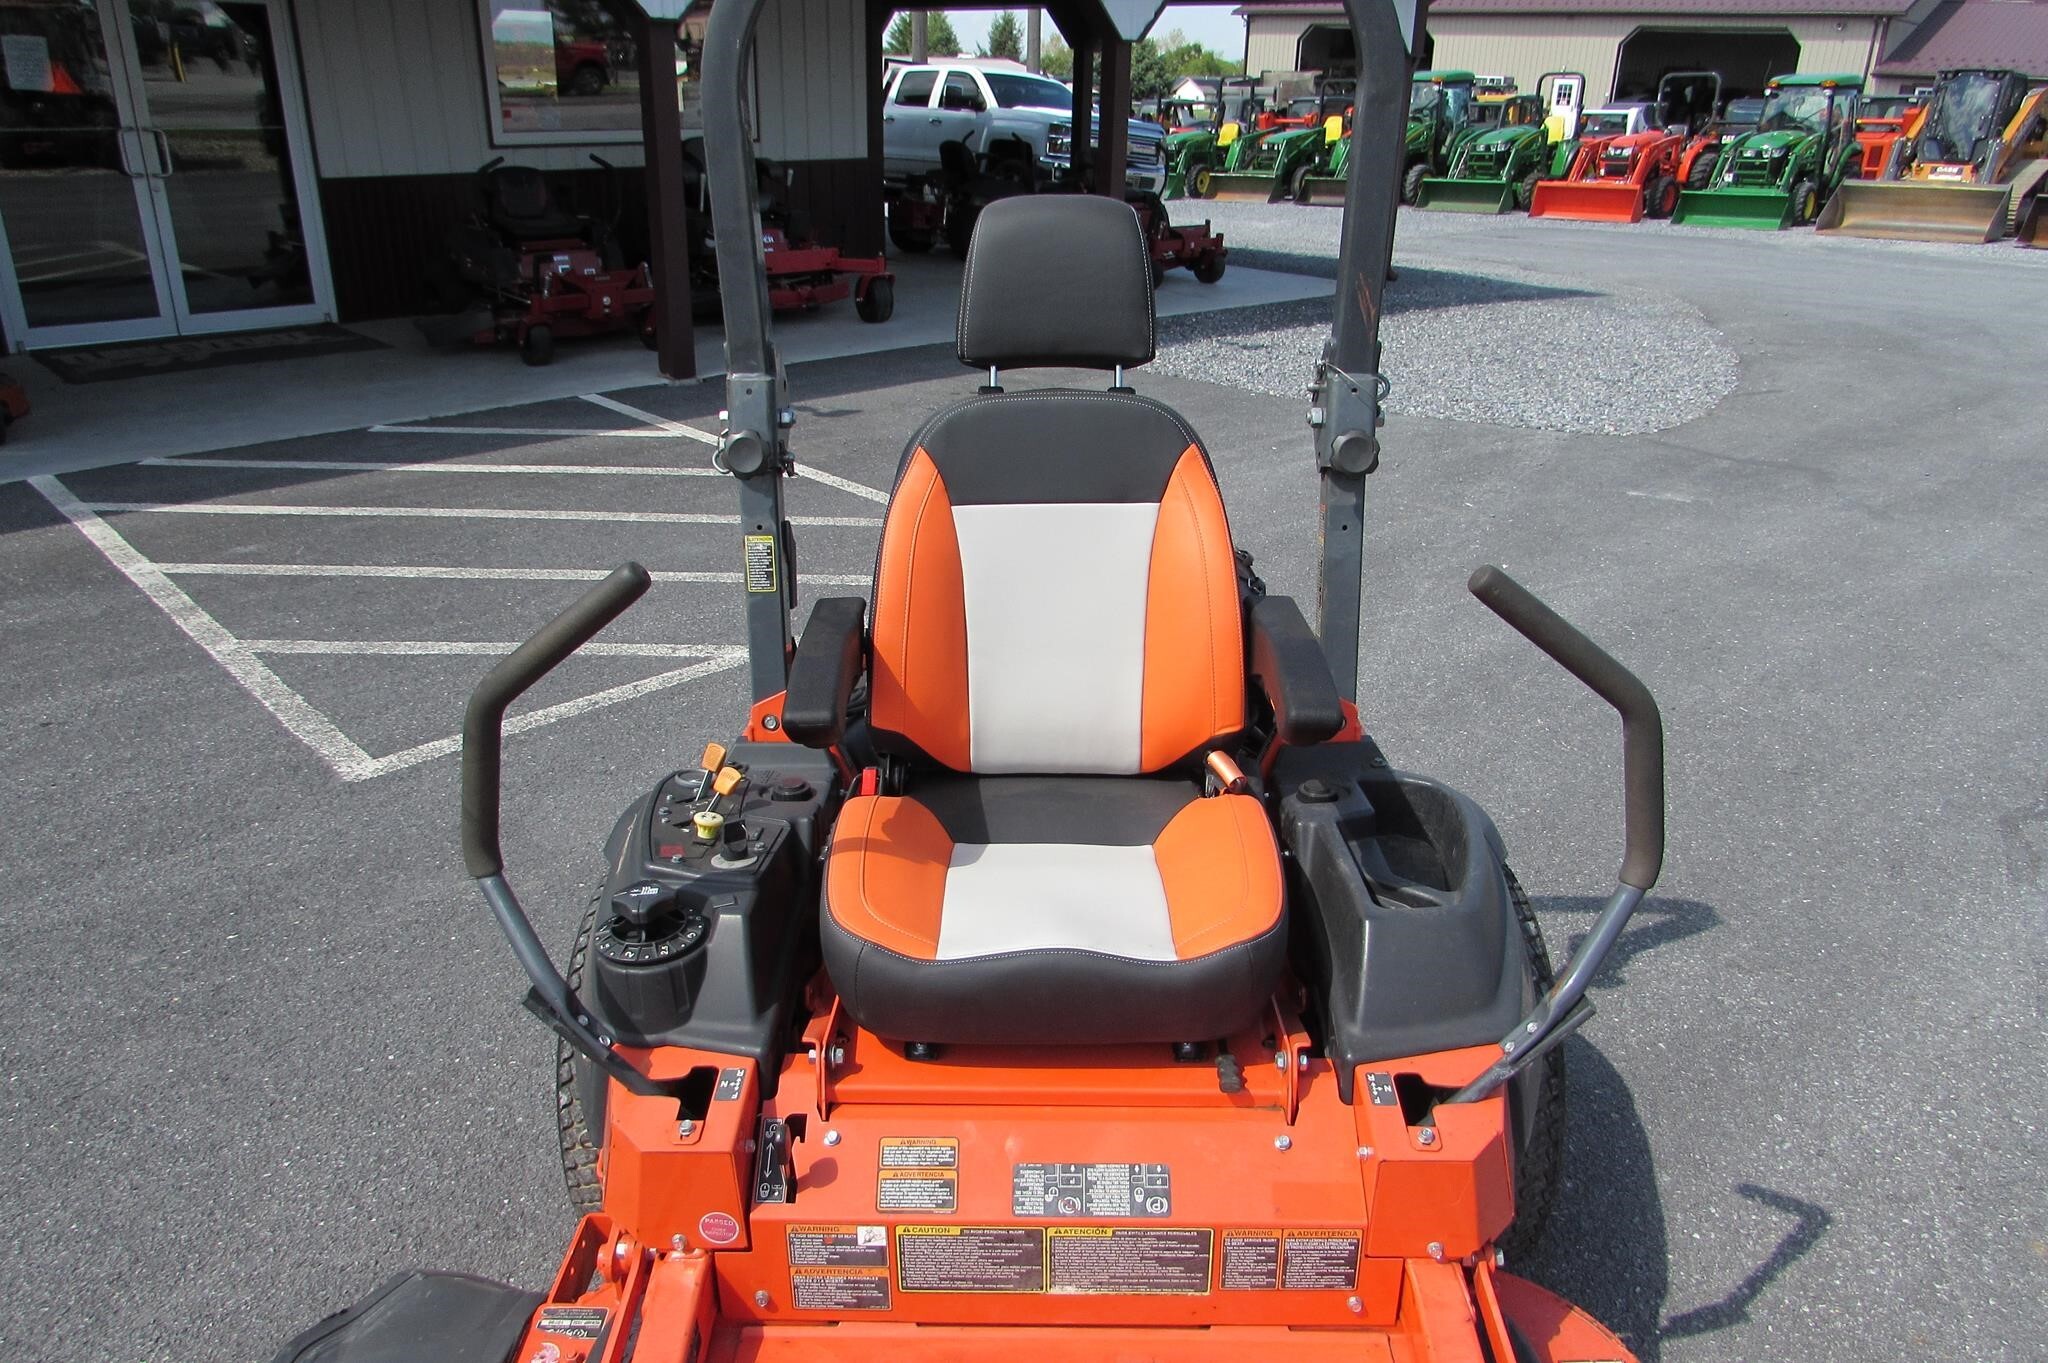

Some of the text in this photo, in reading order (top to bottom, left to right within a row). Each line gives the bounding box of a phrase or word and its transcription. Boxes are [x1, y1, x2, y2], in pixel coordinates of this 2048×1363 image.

[1721, 134, 1735, 144] CAT
[736, 1069, 745, 1077] R
[720, 1080, 729, 1088] N
[1383, 1084, 1392, 1092] N
[1374, 1096, 1381, 1104] F
[799, 1225, 840, 1233] WARNING
